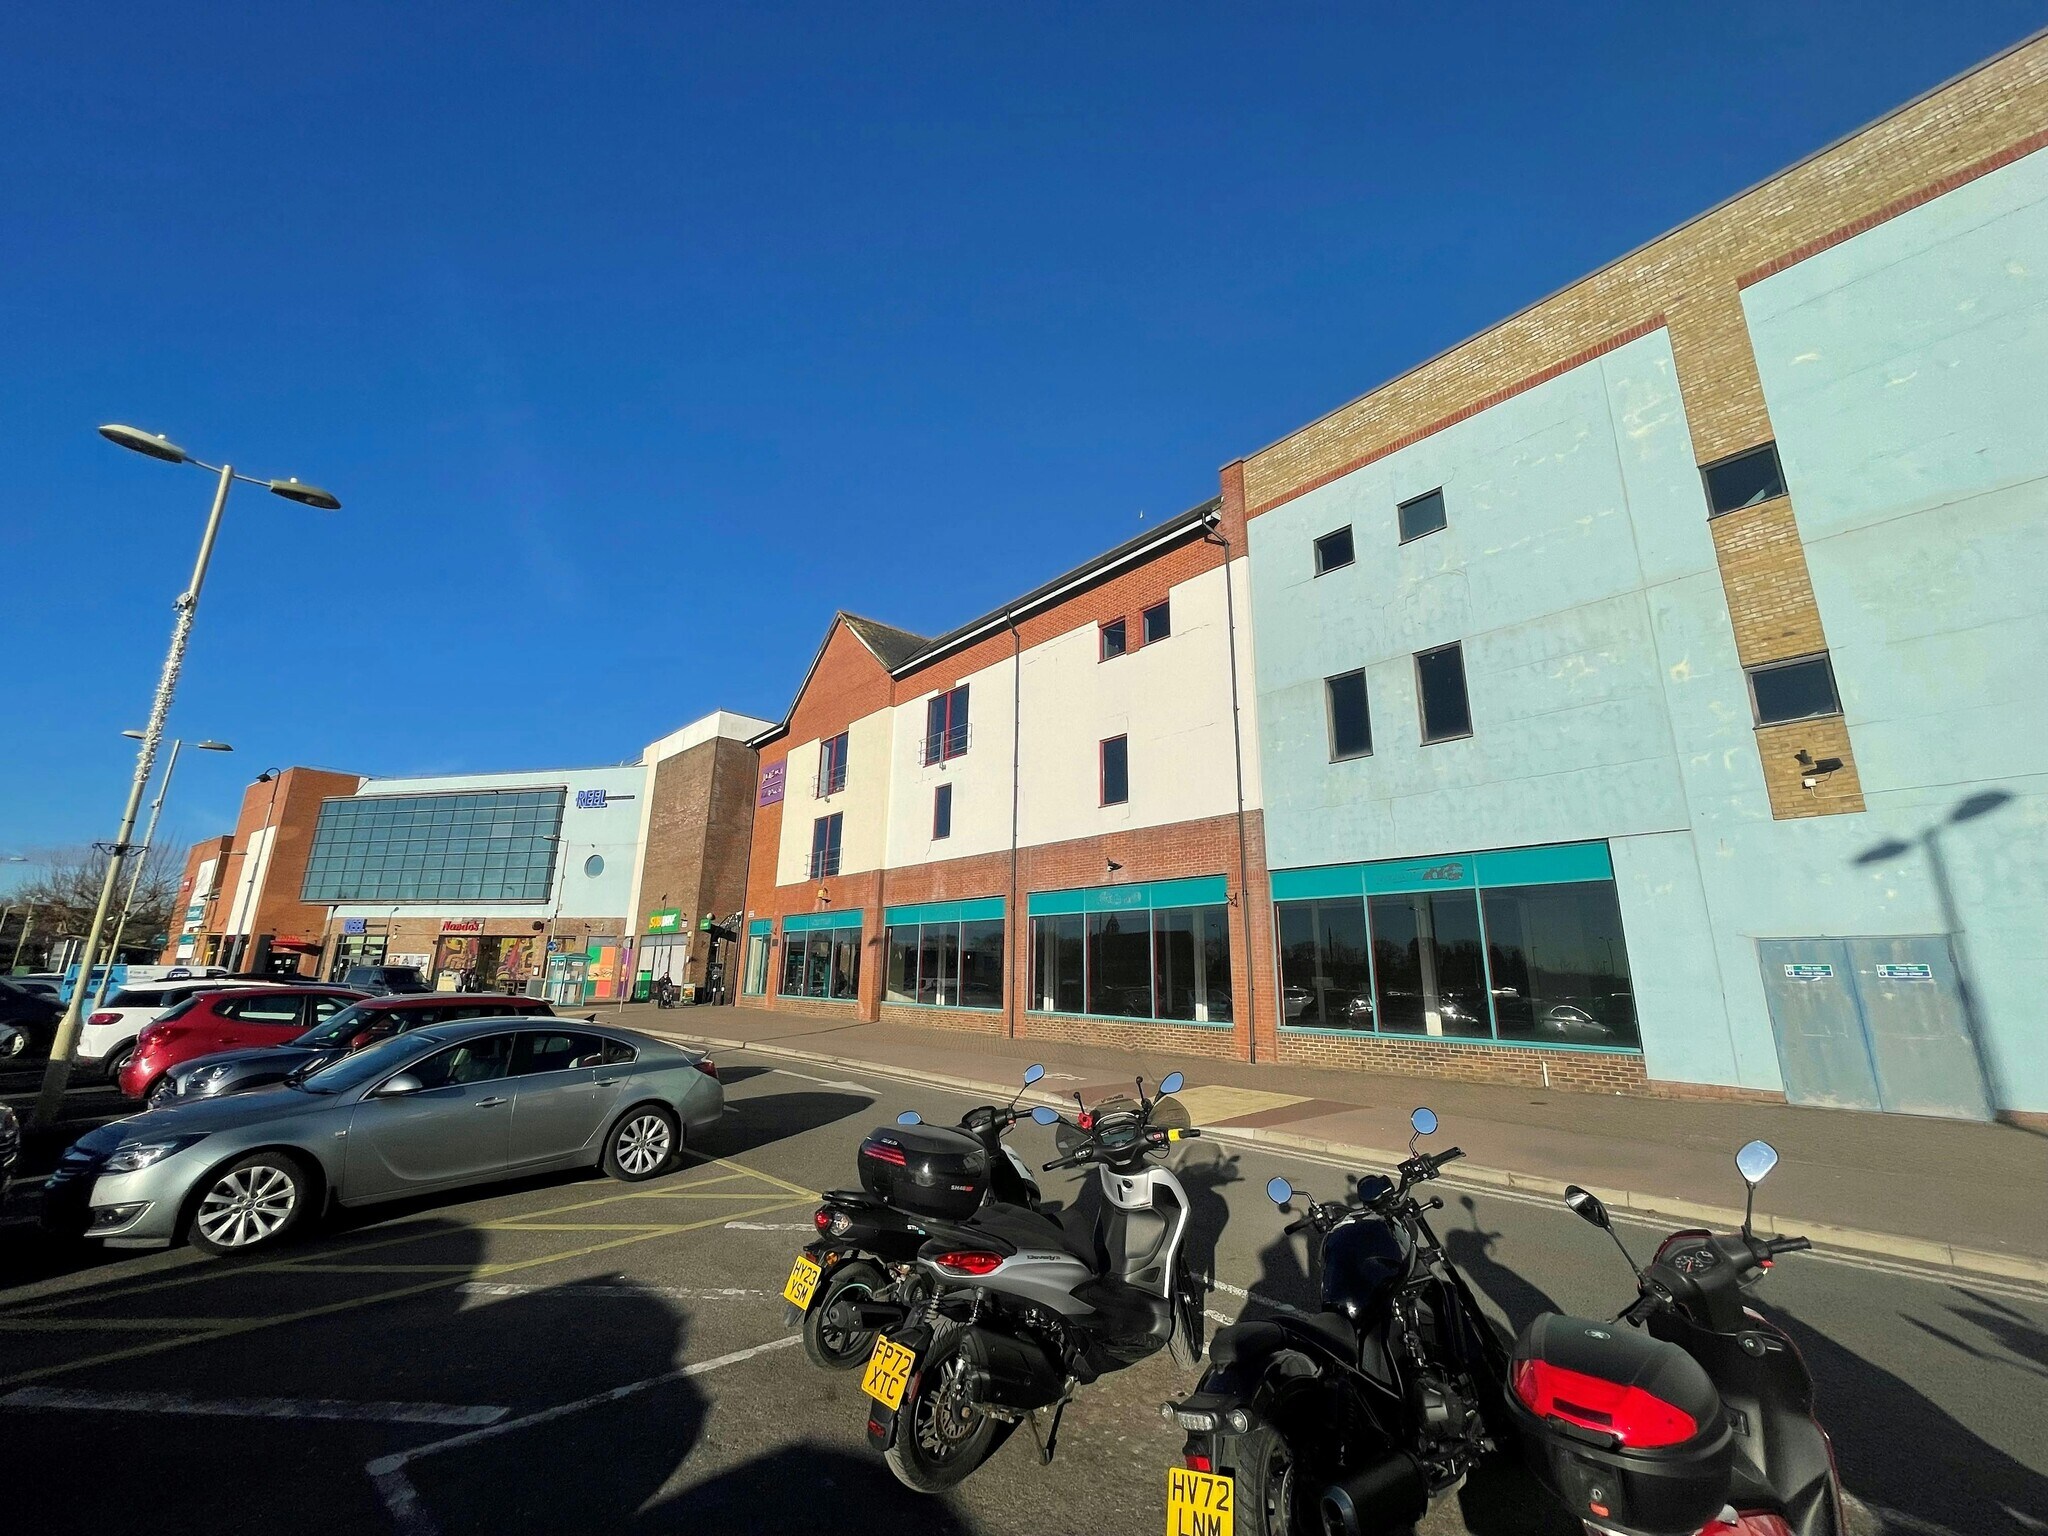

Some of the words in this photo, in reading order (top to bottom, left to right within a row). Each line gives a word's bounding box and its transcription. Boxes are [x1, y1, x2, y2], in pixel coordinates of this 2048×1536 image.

[576, 789, 607, 808] REEL
[442, 920, 480, 931] Nando's
[793, 1261, 818, 1286] HY23
[790, 1279, 809, 1303] YSM
[873, 1341, 912, 1378] FP72
[868, 1366, 899, 1400] XTC
[1172, 1472, 1229, 1511] HV72
[1178, 1507, 1221, 1536] LNM
